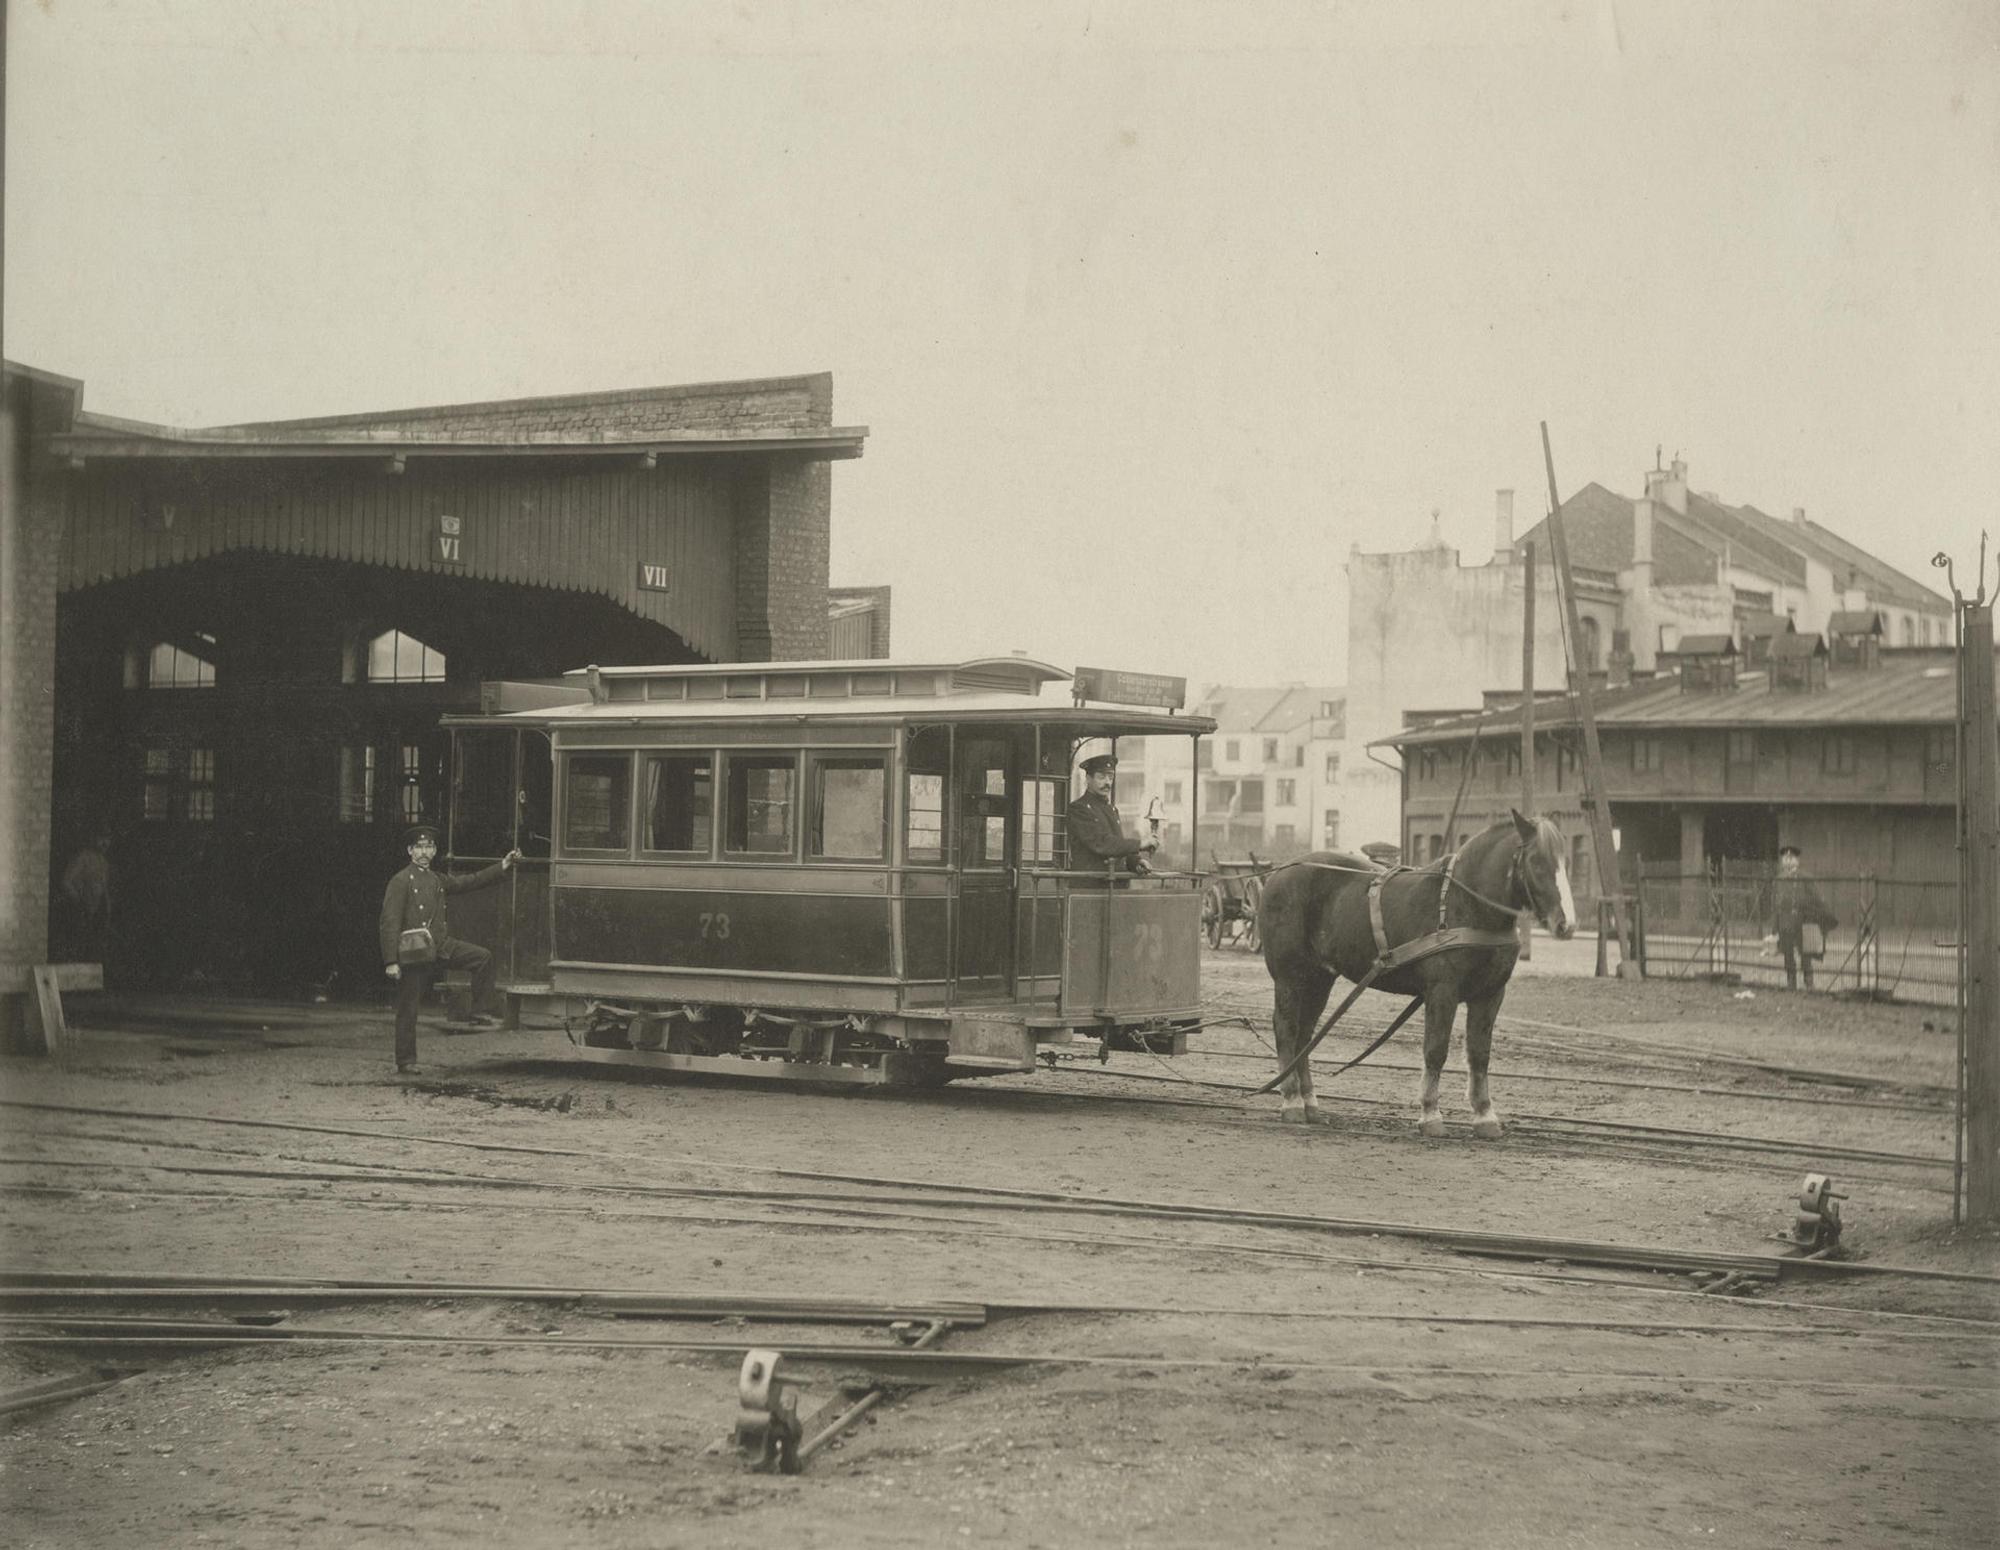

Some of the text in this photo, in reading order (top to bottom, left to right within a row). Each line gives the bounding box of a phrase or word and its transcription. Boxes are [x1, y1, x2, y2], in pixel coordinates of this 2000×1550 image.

[162, 504, 176, 529] V
[439, 536, 461, 561] VI
[643, 564, 668, 588] VII
[699, 912, 730, 940] 73
[1133, 923, 1163, 961] 73
